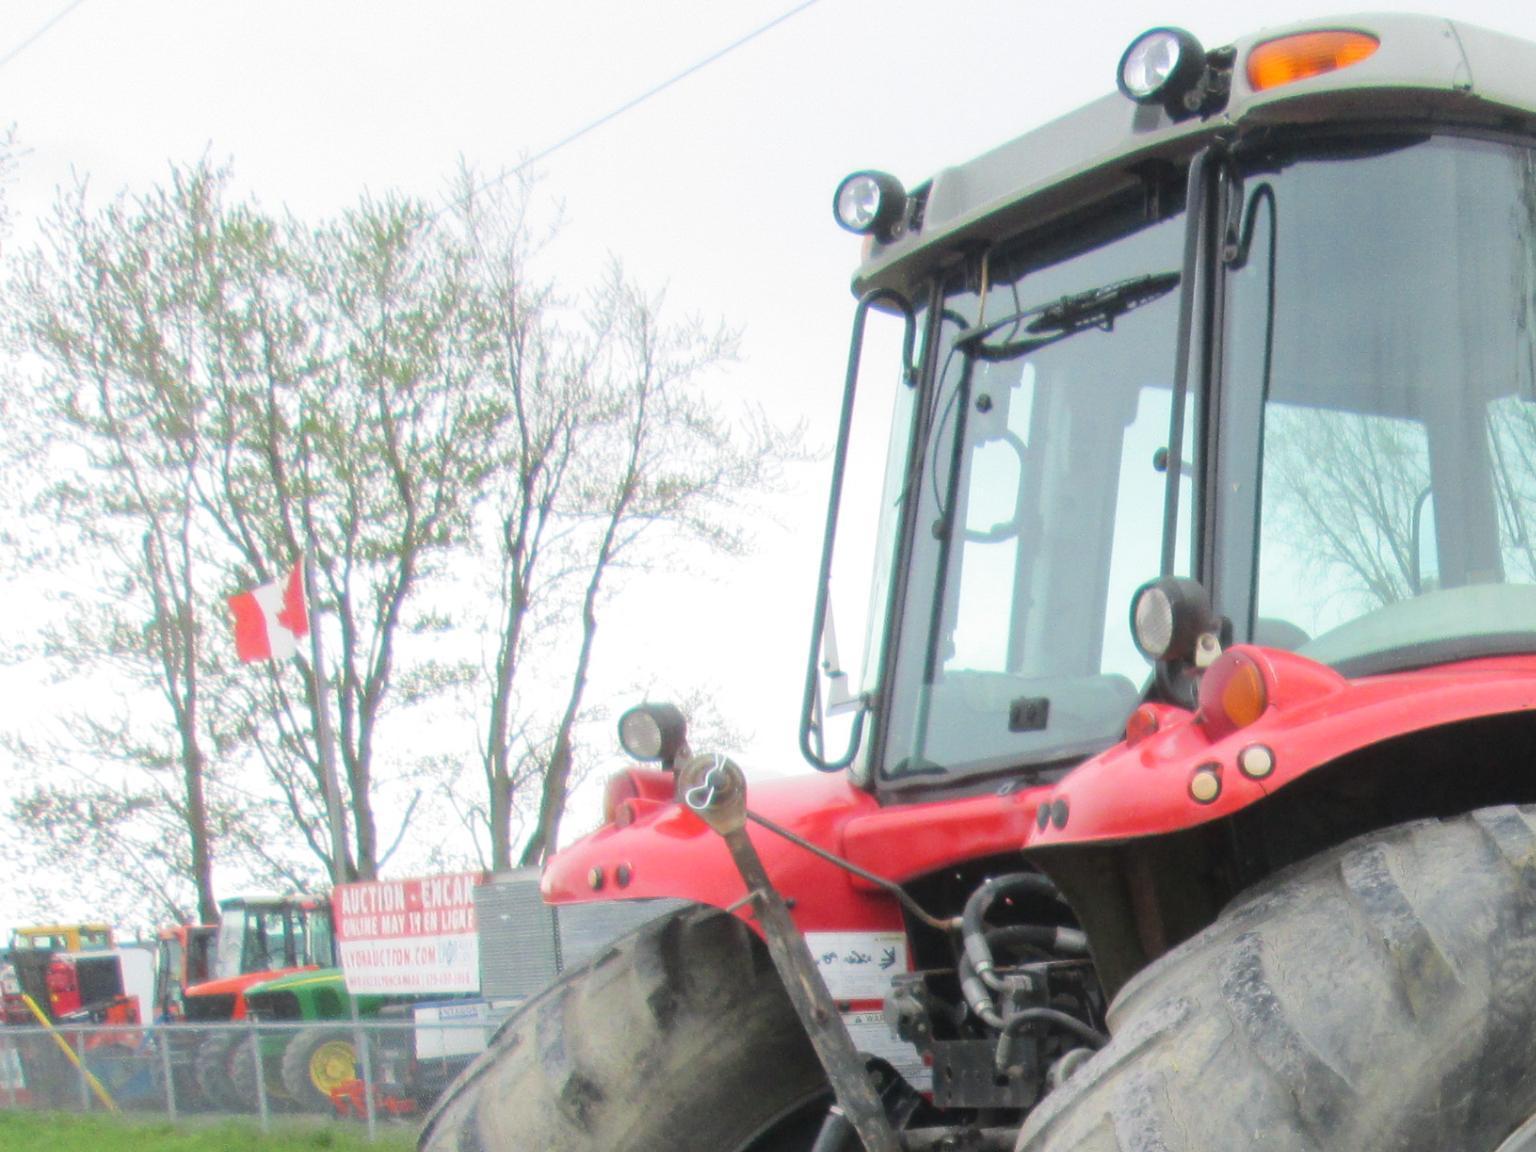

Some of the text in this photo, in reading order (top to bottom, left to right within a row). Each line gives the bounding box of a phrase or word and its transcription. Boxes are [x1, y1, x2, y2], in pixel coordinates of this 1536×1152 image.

[342, 883, 404, 914] AUCTION
[421, 875, 474, 908] ENCAN
[343, 915, 377, 937] ONLINE
[381, 913, 405, 935] MAY
[423, 908, 439, 931] EN
[441, 906, 473, 930] LIGNE
